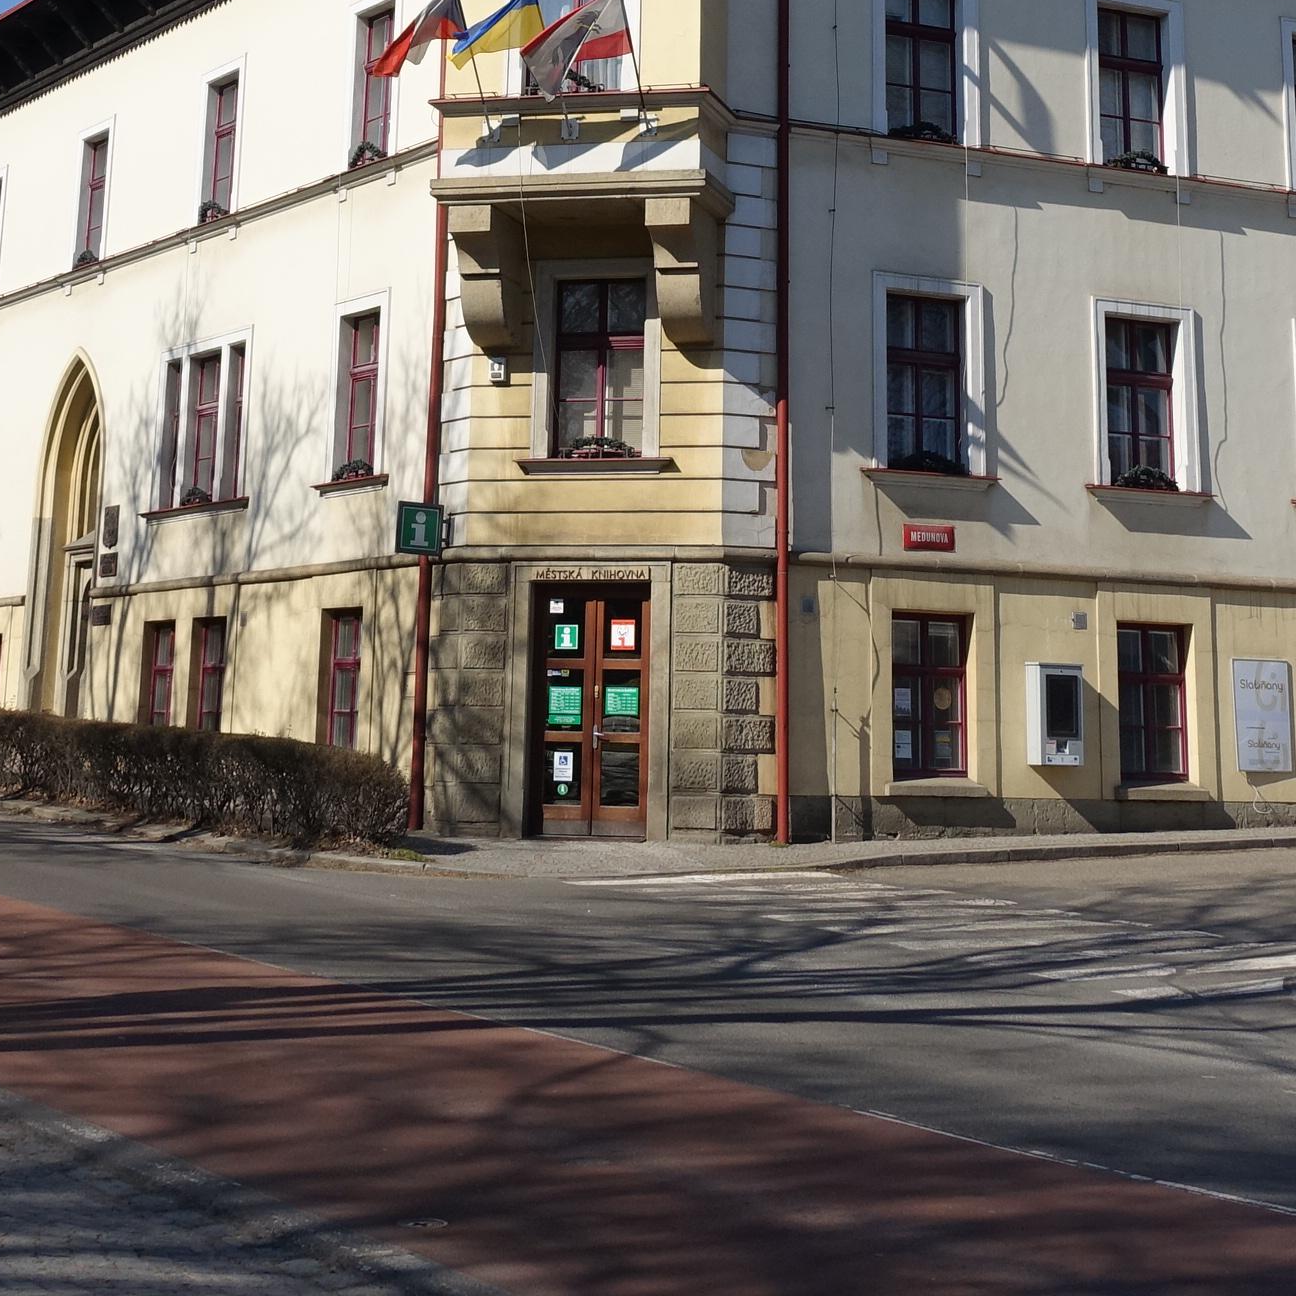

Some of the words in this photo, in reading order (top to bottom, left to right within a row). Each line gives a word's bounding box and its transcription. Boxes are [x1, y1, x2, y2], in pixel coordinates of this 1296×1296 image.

[910, 531, 949, 543] MEDUNOVA
[536, 567, 583, 579] MĚSTSKÁ
[591, 569, 646, 580] KNIHOVNA
